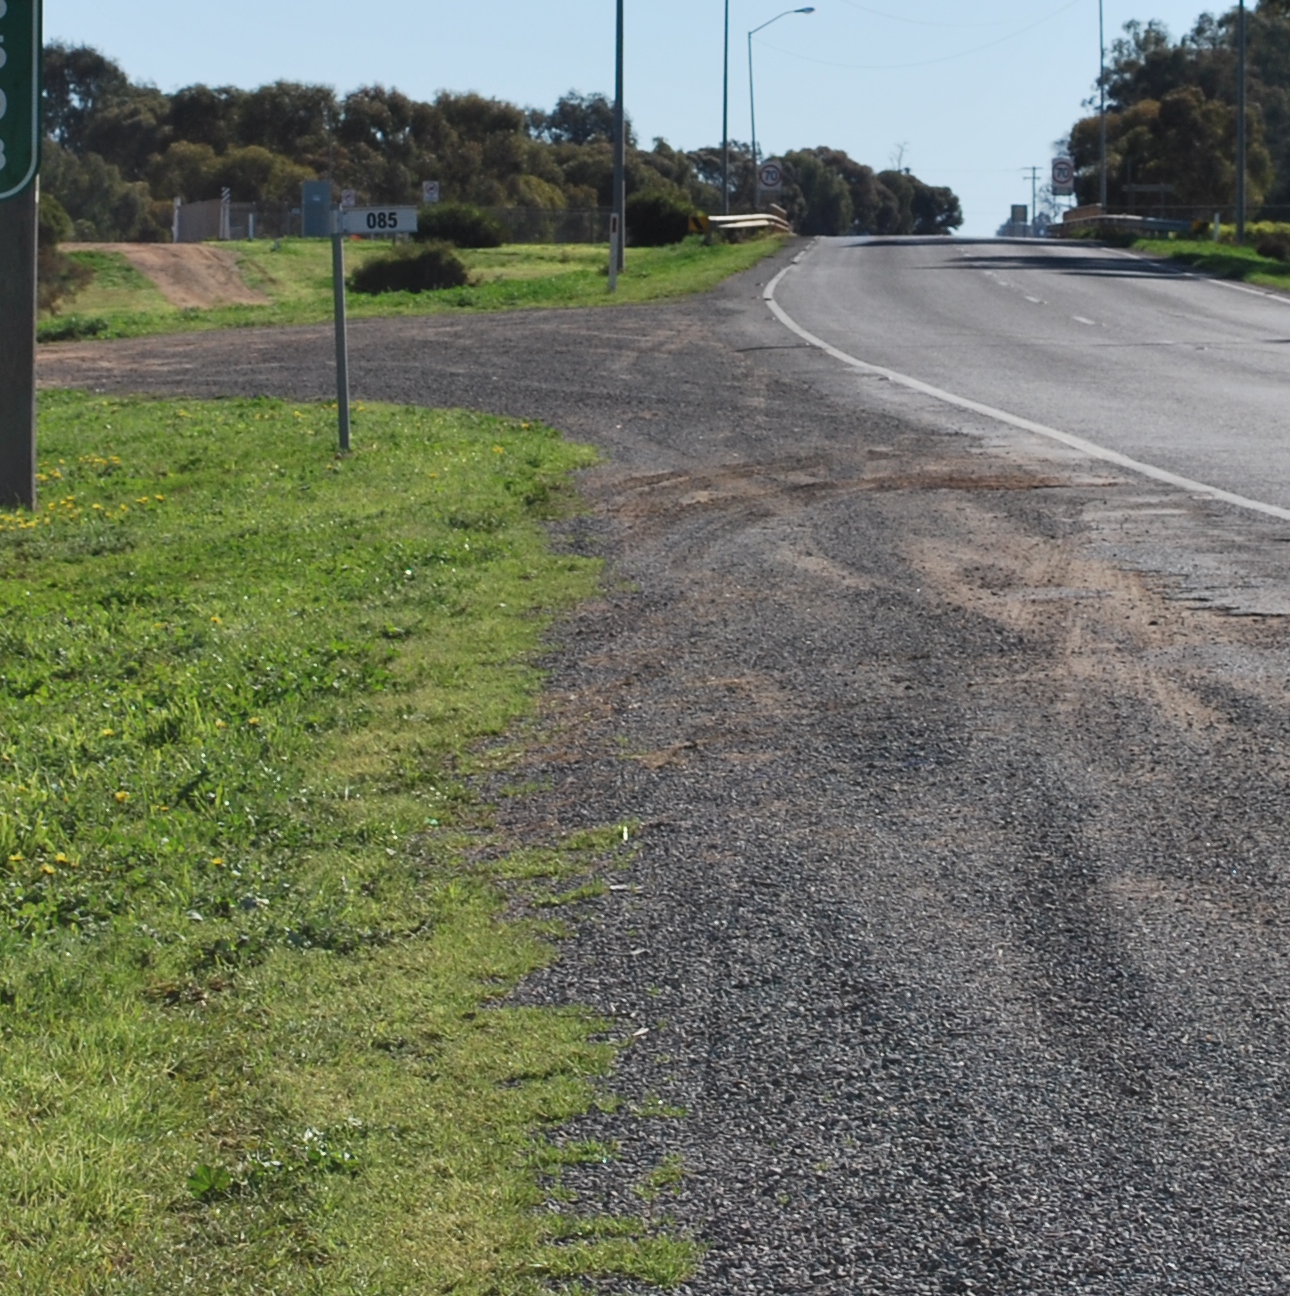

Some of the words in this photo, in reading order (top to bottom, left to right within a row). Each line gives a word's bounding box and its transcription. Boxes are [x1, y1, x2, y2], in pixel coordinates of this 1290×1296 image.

[765, 170, 777, 181] 70
[1056, 167, 1069, 178] 70
[366, 211, 398, 229] 085
